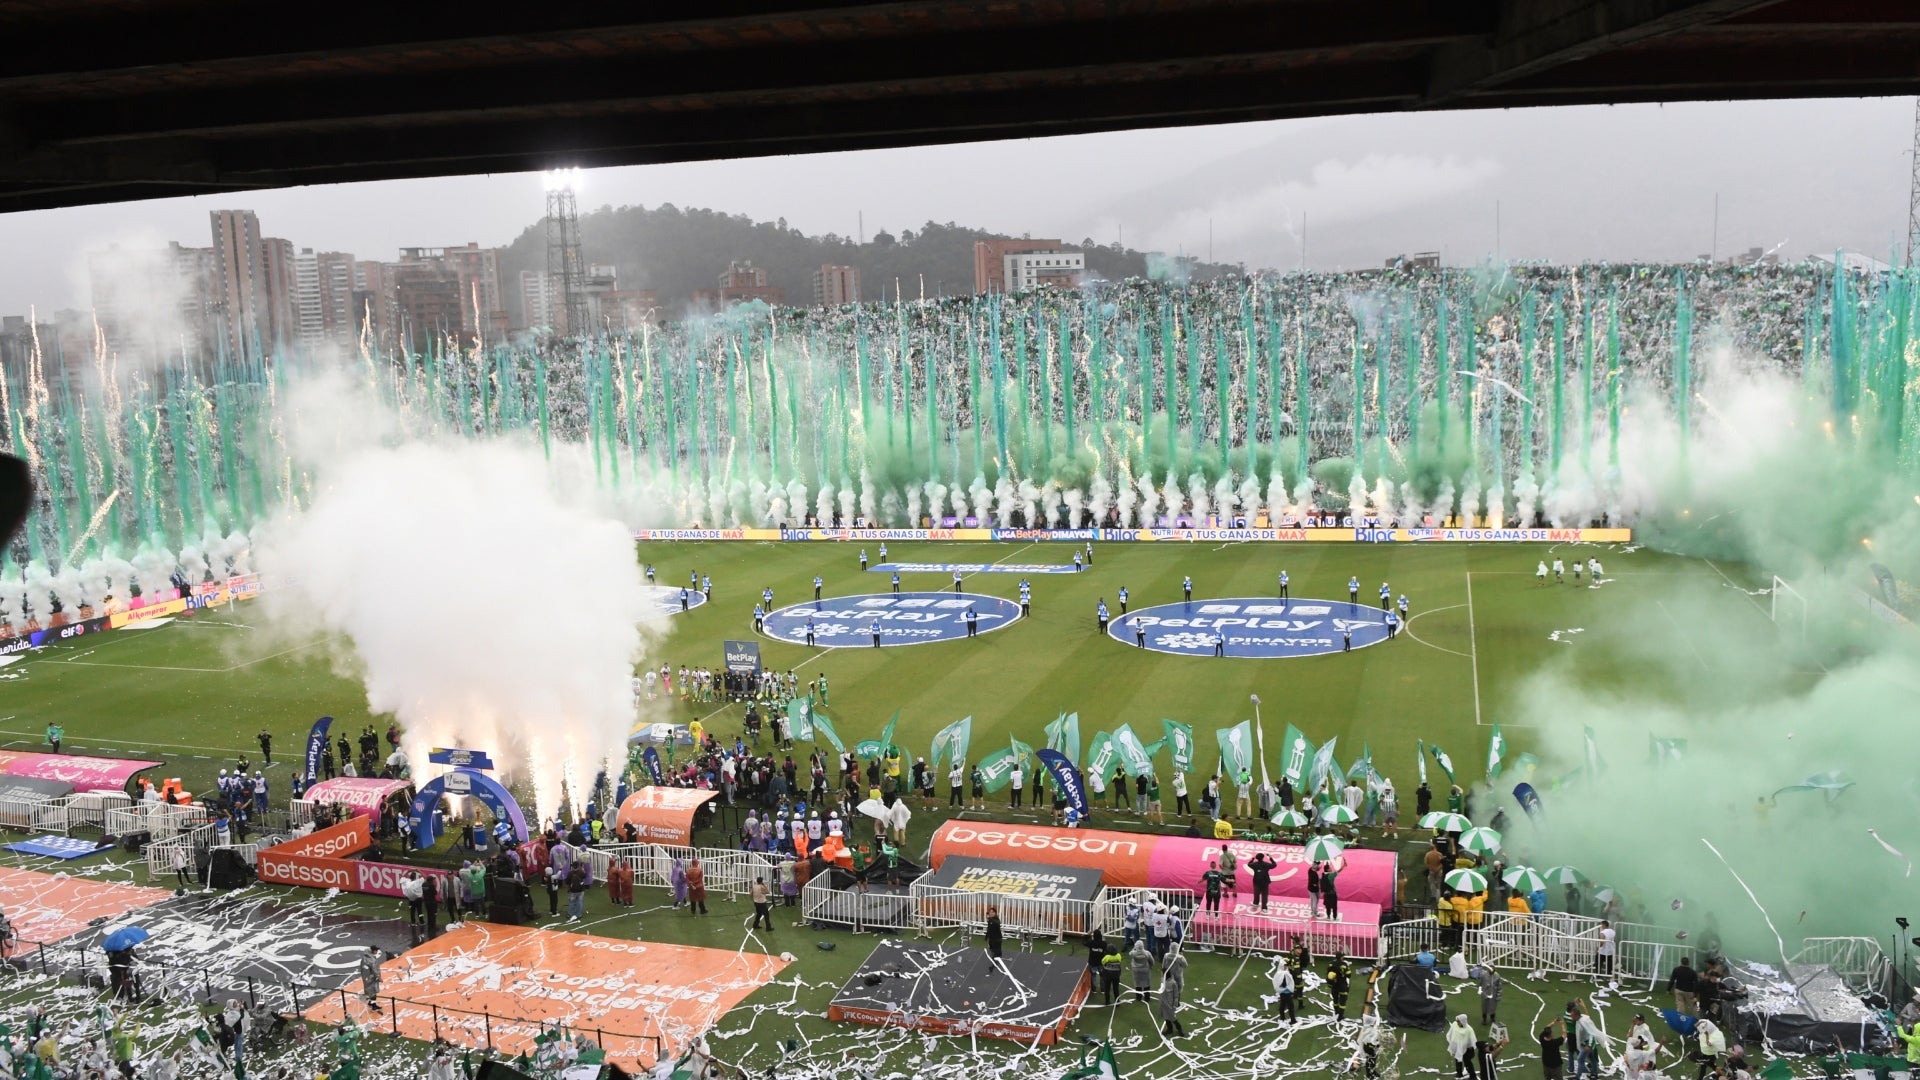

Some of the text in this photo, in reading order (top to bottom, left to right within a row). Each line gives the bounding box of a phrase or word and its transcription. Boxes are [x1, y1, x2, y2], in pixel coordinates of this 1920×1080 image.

[660, 530, 675, 538] TUS
[676, 530, 707, 538] GANAS
[709, 530, 721, 538] DE
[722, 529, 744, 539] MAX
[879, 530, 913, 539] GANAS
[914, 530, 928, 539] DE
[929, 529, 954, 539] MAX
[998, 531, 1093, 541] LIGA BetPlay DIMAYOR
[1196, 531, 1216, 539] TUS
[1219, 531, 1259, 539] GANAS
[1262, 531, 1276, 539] DE
[1278, 529, 1307, 540] MAX
[1458, 531, 1480, 540] TUS
[1484, 531, 1528, 540] GANAS
[1531, 531, 1547, 540] DE
[1550, 528, 1581, 540] MAX
[127, 606, 168, 620] Alkomprar
[782, 608, 952, 623] BetPlay
[1125, 616, 1322, 631] BetPlay
[61, 626, 75, 638] elf
[726, 653, 757, 663] BetPlay
[308, 738, 321, 780] BetPlay
[945, 826, 1138, 856] betsson
[262, 857, 350, 885] betsson
[963, 867, 1077, 884] UN ESCENARIO
[958, 873, 1039, 887] LLAMADO
